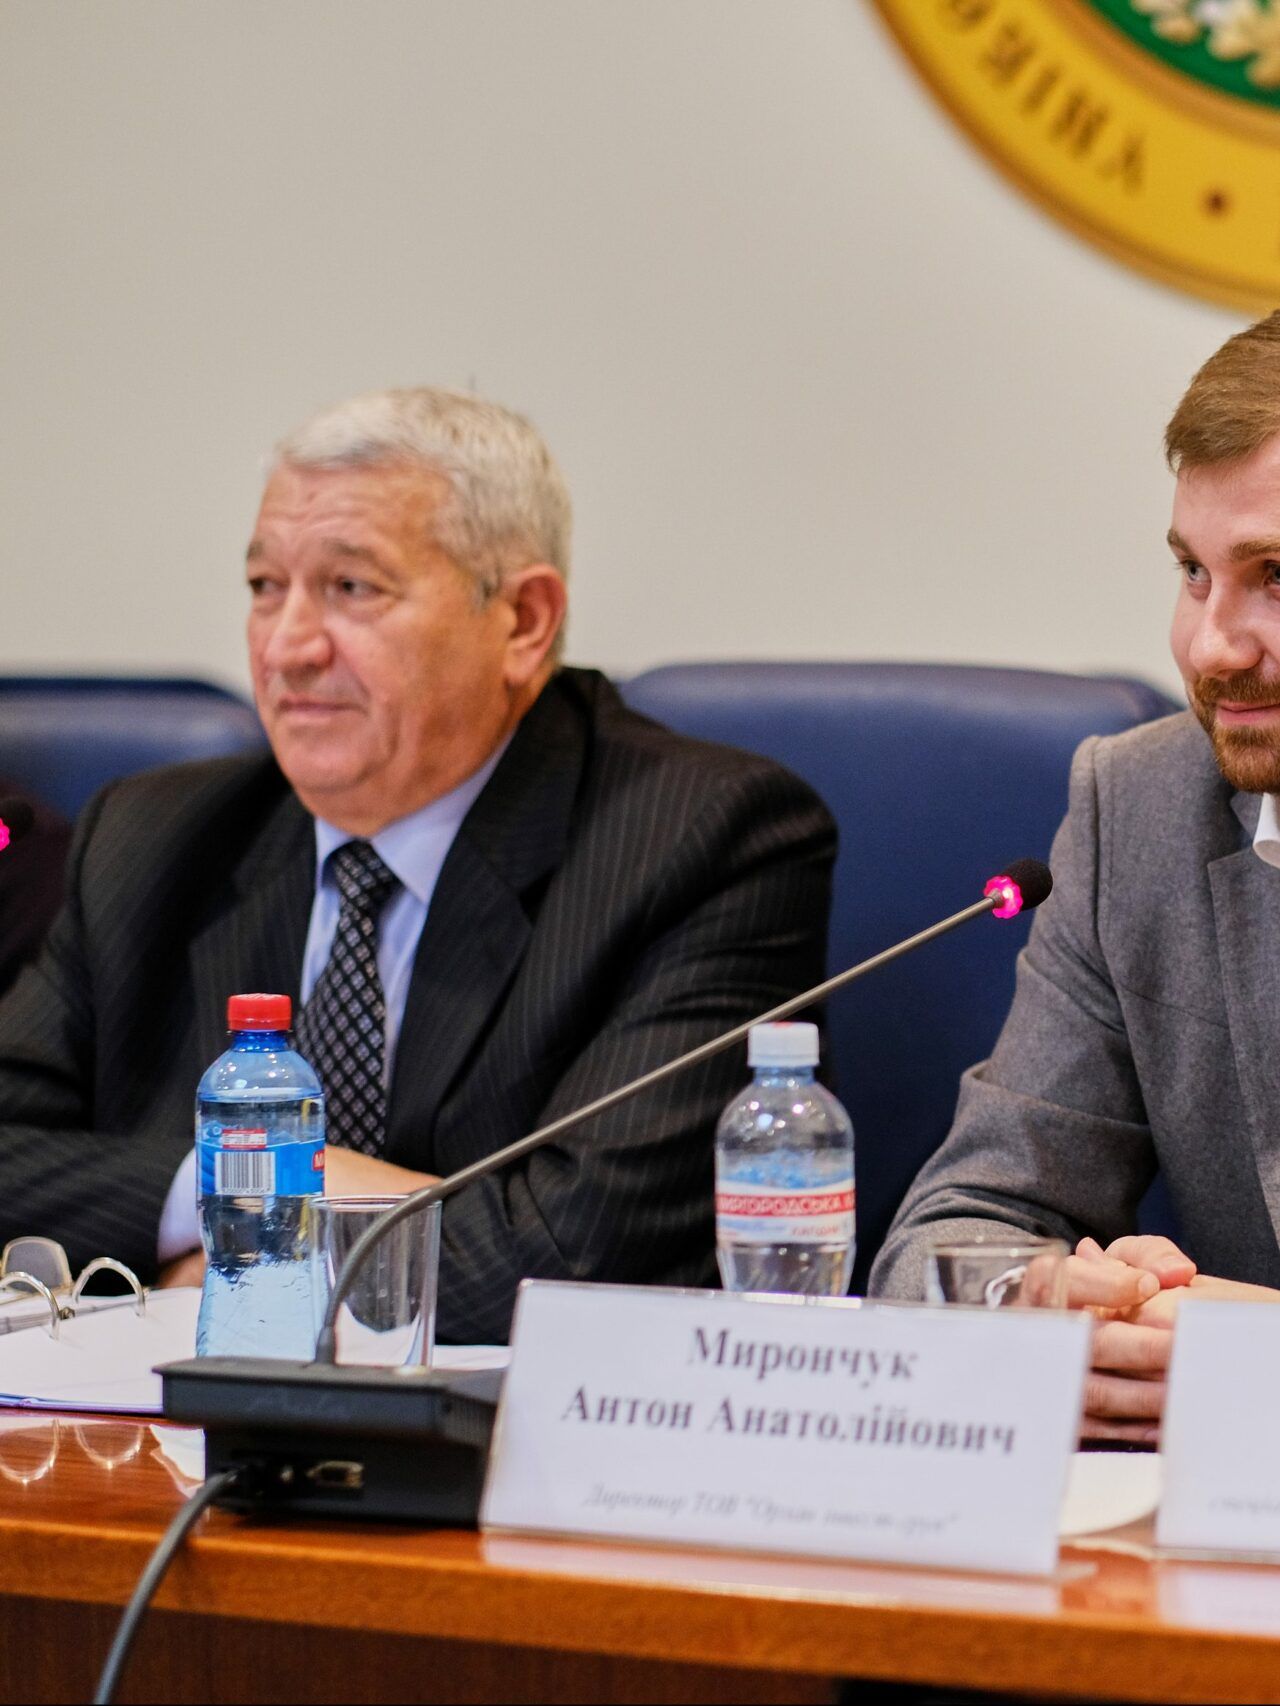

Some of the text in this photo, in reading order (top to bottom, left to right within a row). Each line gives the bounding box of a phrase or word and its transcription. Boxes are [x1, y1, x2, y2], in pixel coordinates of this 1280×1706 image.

[688, 1326, 919, 1388] Мирончук
[561, 1386, 1018, 1456] Антон Анатолійович
